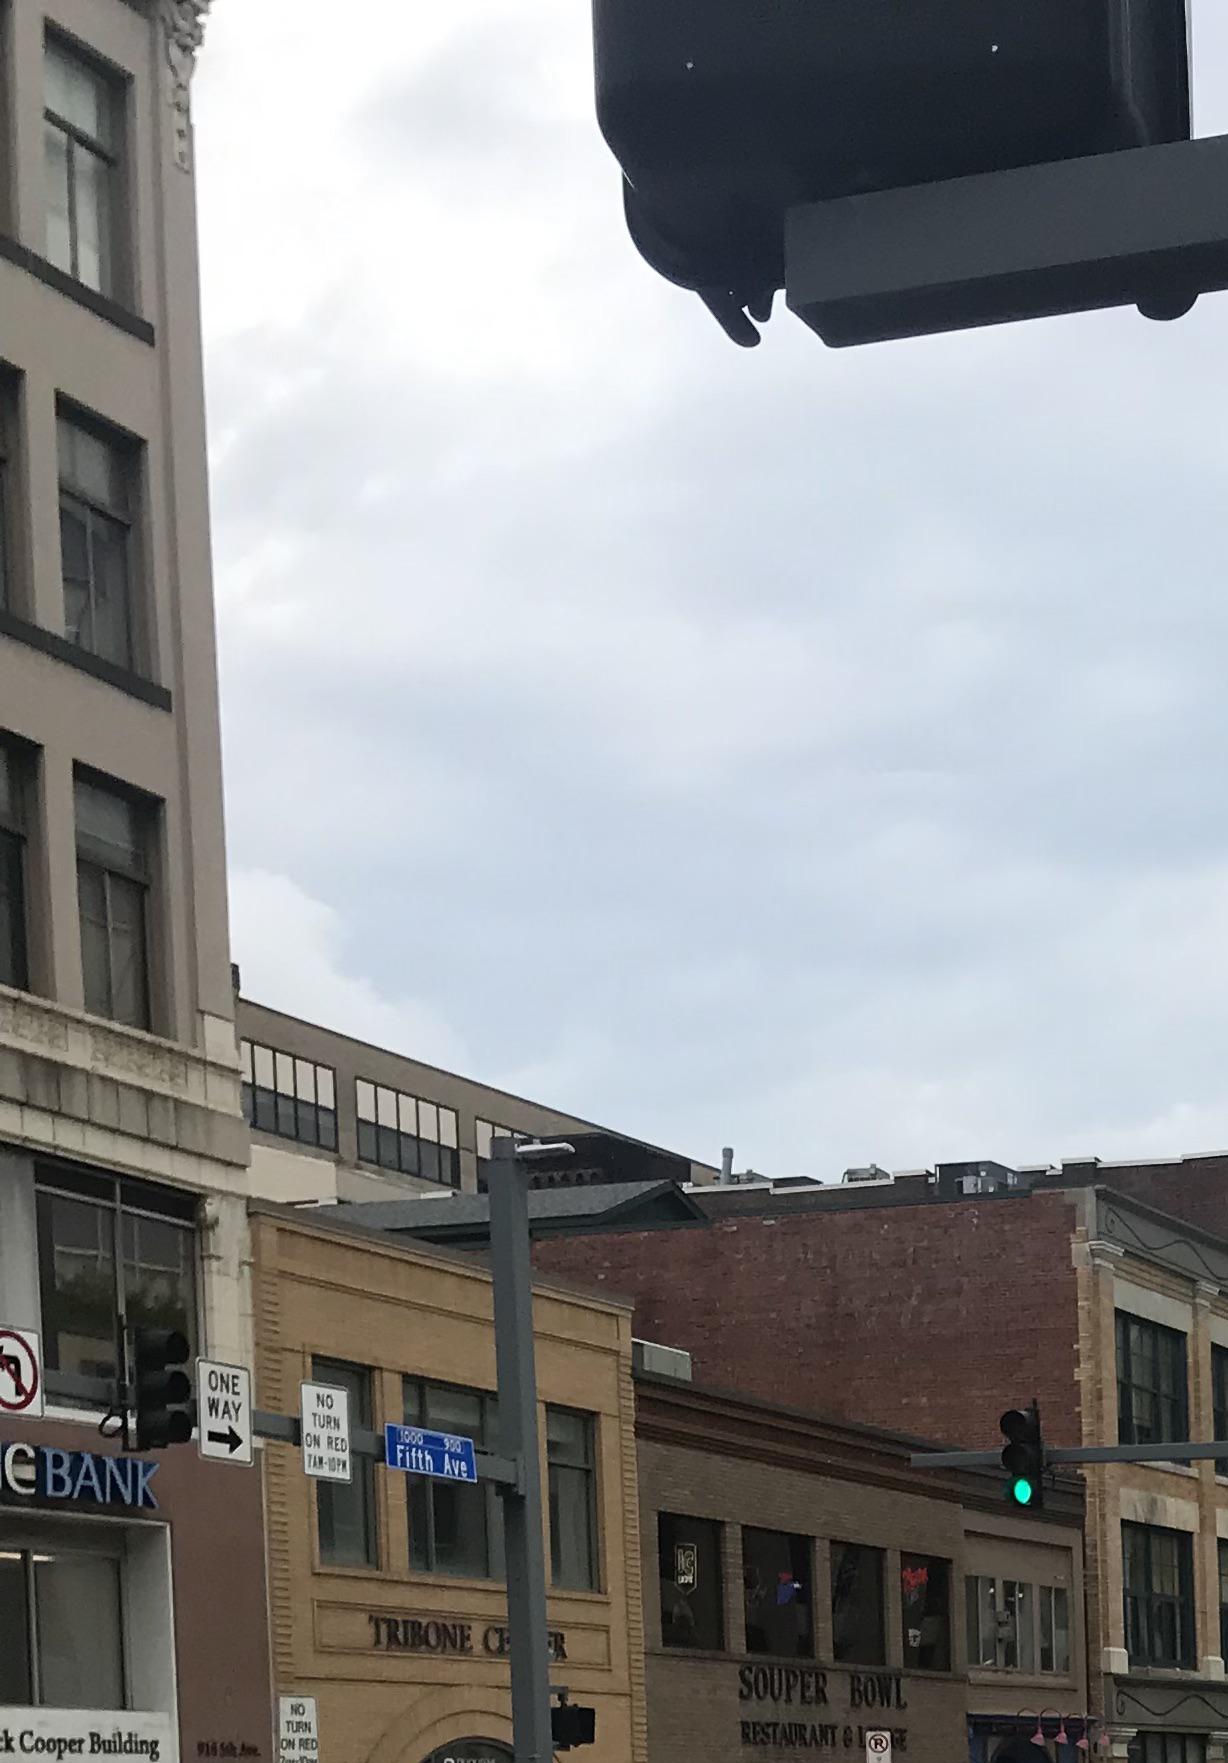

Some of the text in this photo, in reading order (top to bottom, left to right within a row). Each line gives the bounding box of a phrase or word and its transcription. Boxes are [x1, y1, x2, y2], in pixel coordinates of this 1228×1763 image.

[207, 1369, 241, 1396] ONE
[207, 1396, 242, 1423] WAY
[316, 1393, 334, 1409] NO
[312, 1412, 340, 1432] TURN
[305, 1432, 347, 1452] ON RED
[400, 1430, 424, 1445] 1000
[396, 1444, 468, 1478] Fifth Ave
[43, 1446, 160, 1509] BANK
[368, 1614, 473, 1653] TRIBONE
[738, 1664, 908, 1711] SOUPER BOWL
[290, 1703, 305, 1716] NO
[285, 1720, 311, 1733] TURN
[740, 1720, 838, 1748] RESTAURANT
[19, 1729, 86, 1761] Cooper
[89, 1731, 160, 1762] Building
[281, 1738, 318, 1751] ON RED
